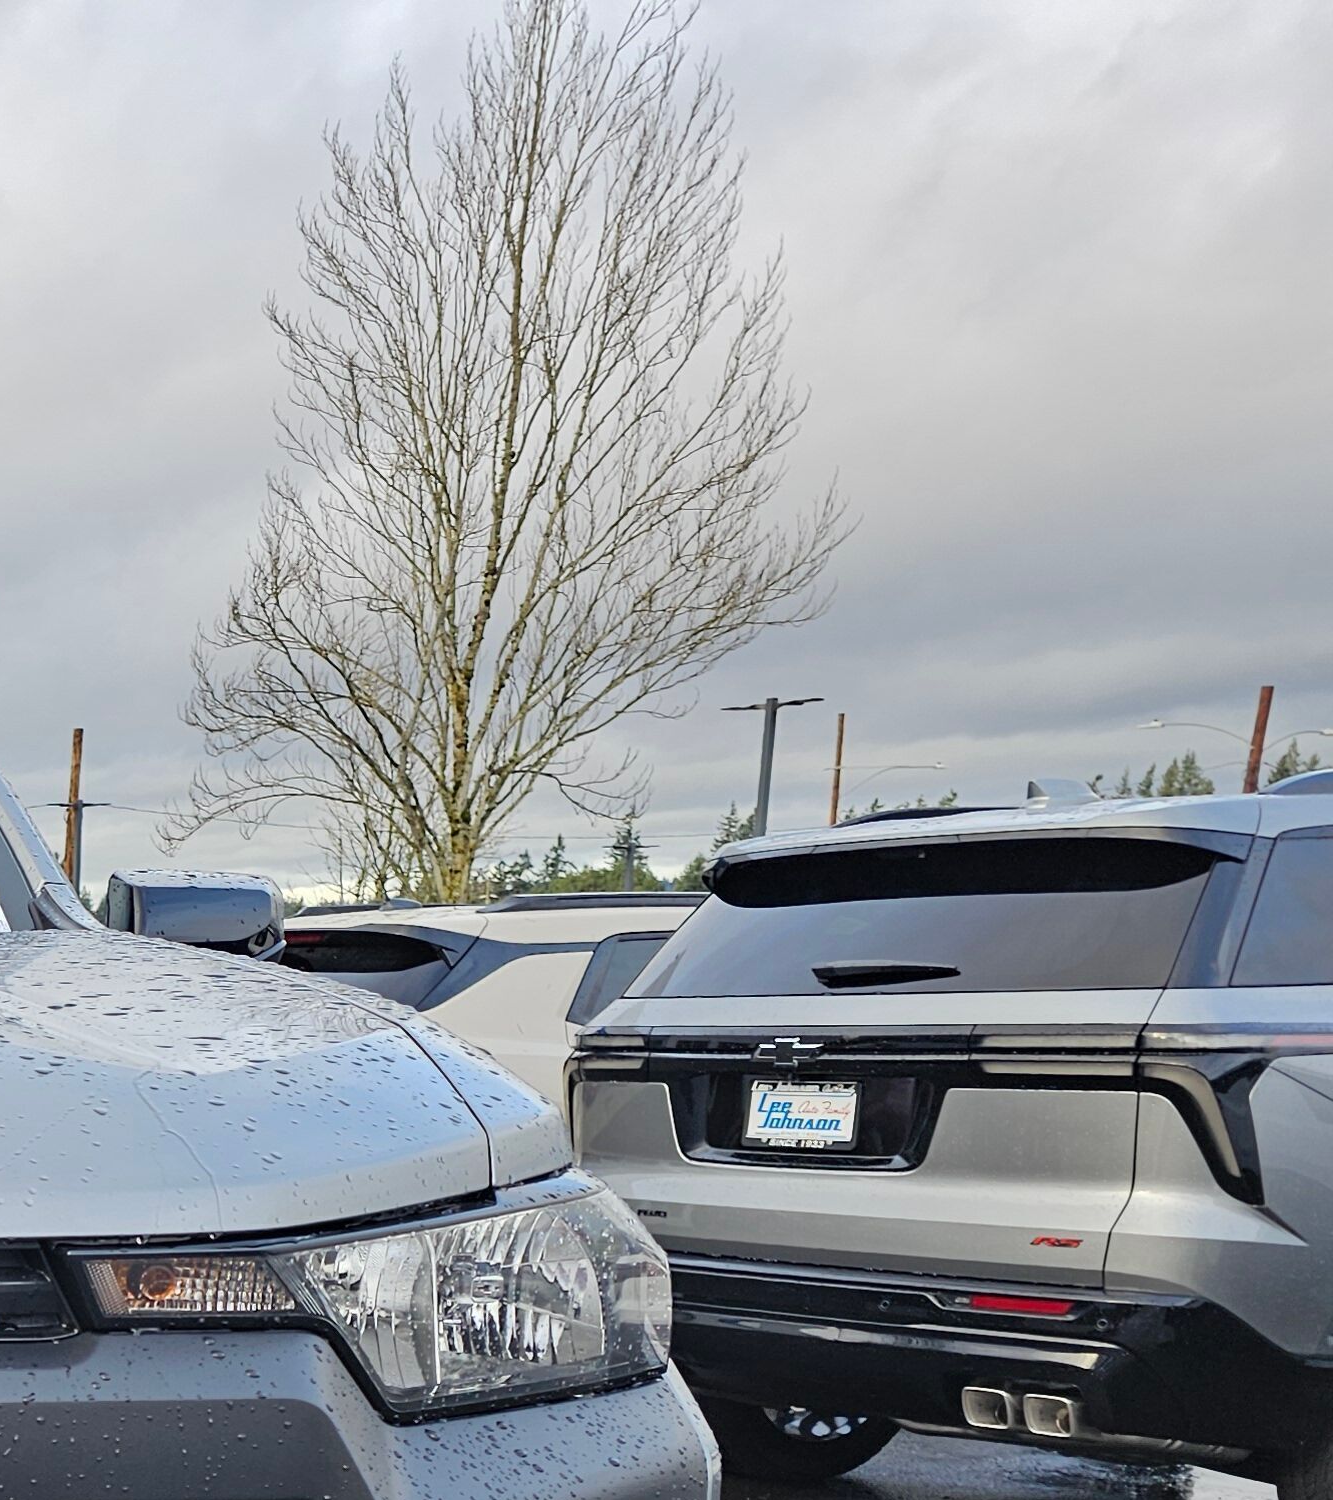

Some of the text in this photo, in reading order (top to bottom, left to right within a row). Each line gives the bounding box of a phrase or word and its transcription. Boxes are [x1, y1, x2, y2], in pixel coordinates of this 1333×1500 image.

[758, 1092, 794, 1114] Lee
[757, 1110, 842, 1131] Johnson
[1030, 1236, 1084, 1249] RS
